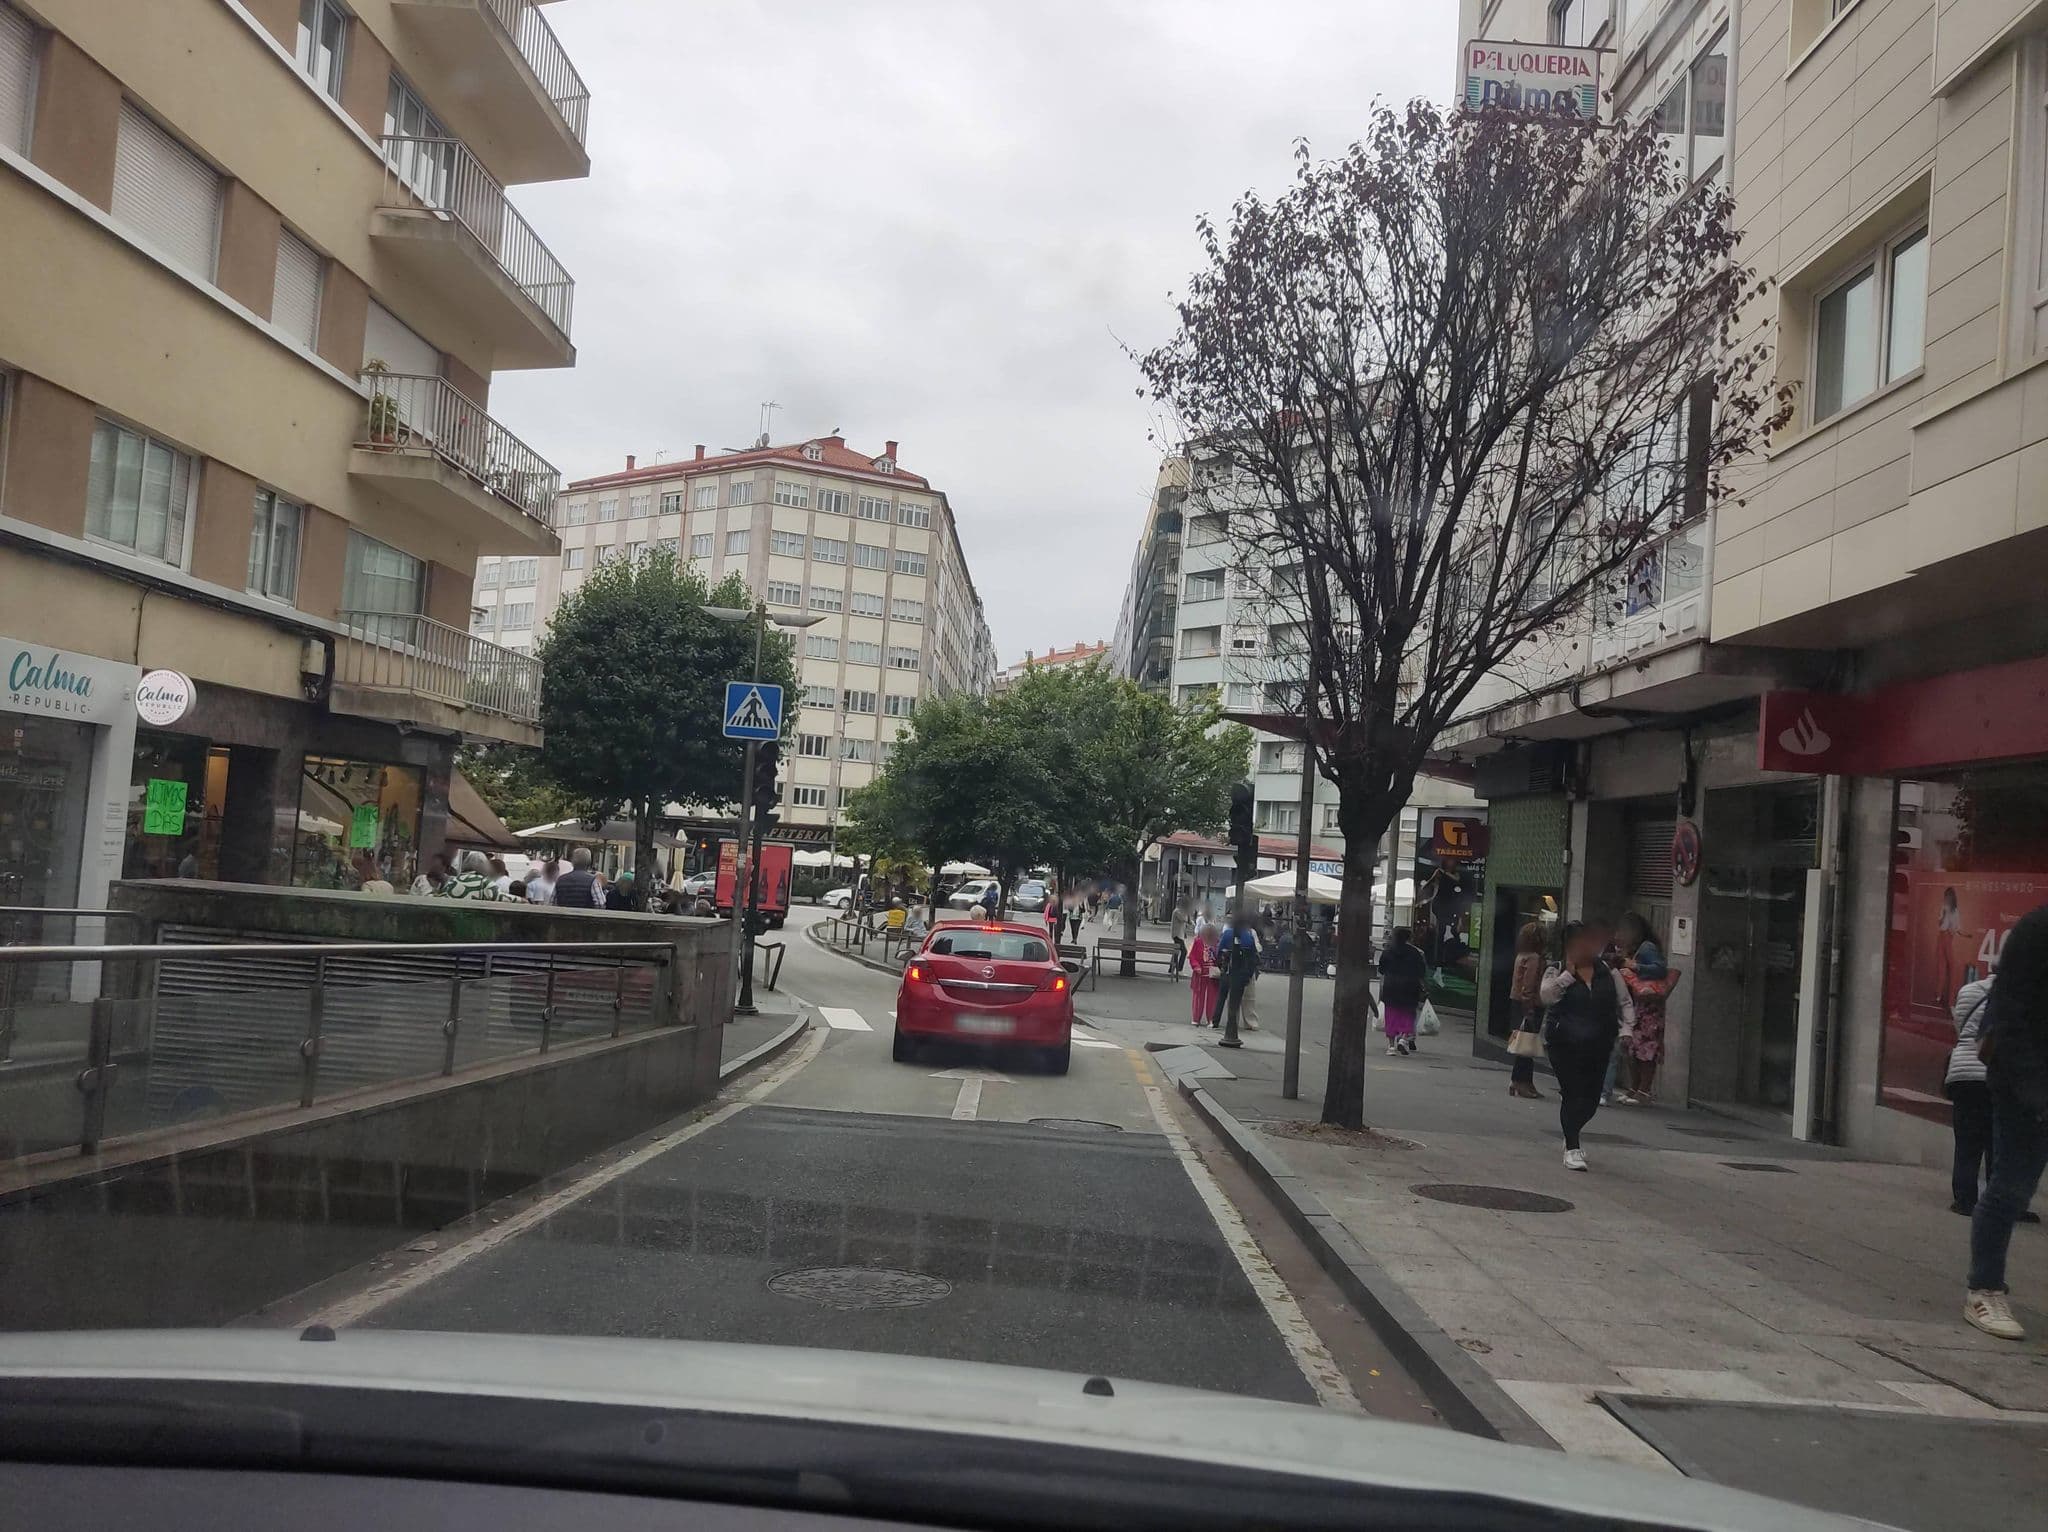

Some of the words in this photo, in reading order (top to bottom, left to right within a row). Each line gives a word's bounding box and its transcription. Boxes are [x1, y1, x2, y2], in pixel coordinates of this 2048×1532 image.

[9, 651, 94, 697] Calma
[138, 686, 184, 702] Calma
[1436, 848, 1472, 856] TABACOS
